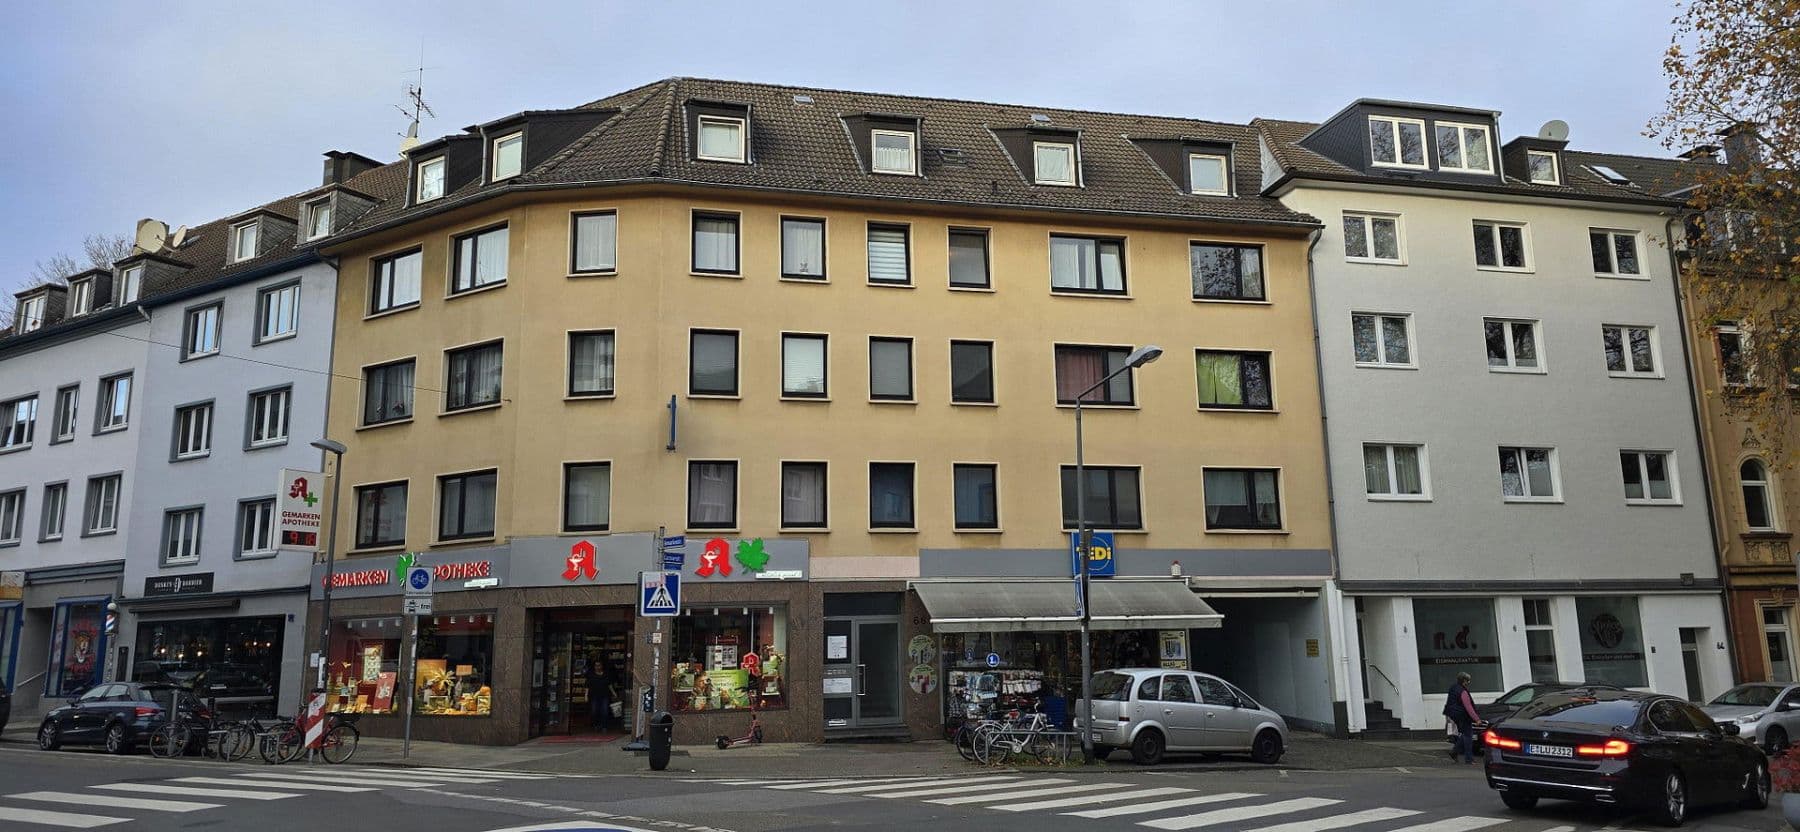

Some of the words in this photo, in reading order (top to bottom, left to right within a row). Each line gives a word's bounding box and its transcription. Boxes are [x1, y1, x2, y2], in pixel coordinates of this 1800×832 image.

[281, 511, 320, 520] GEMARKEN
[281, 519, 320, 527] APOTHEKE
[433, 560, 490, 581] POTHEKE
